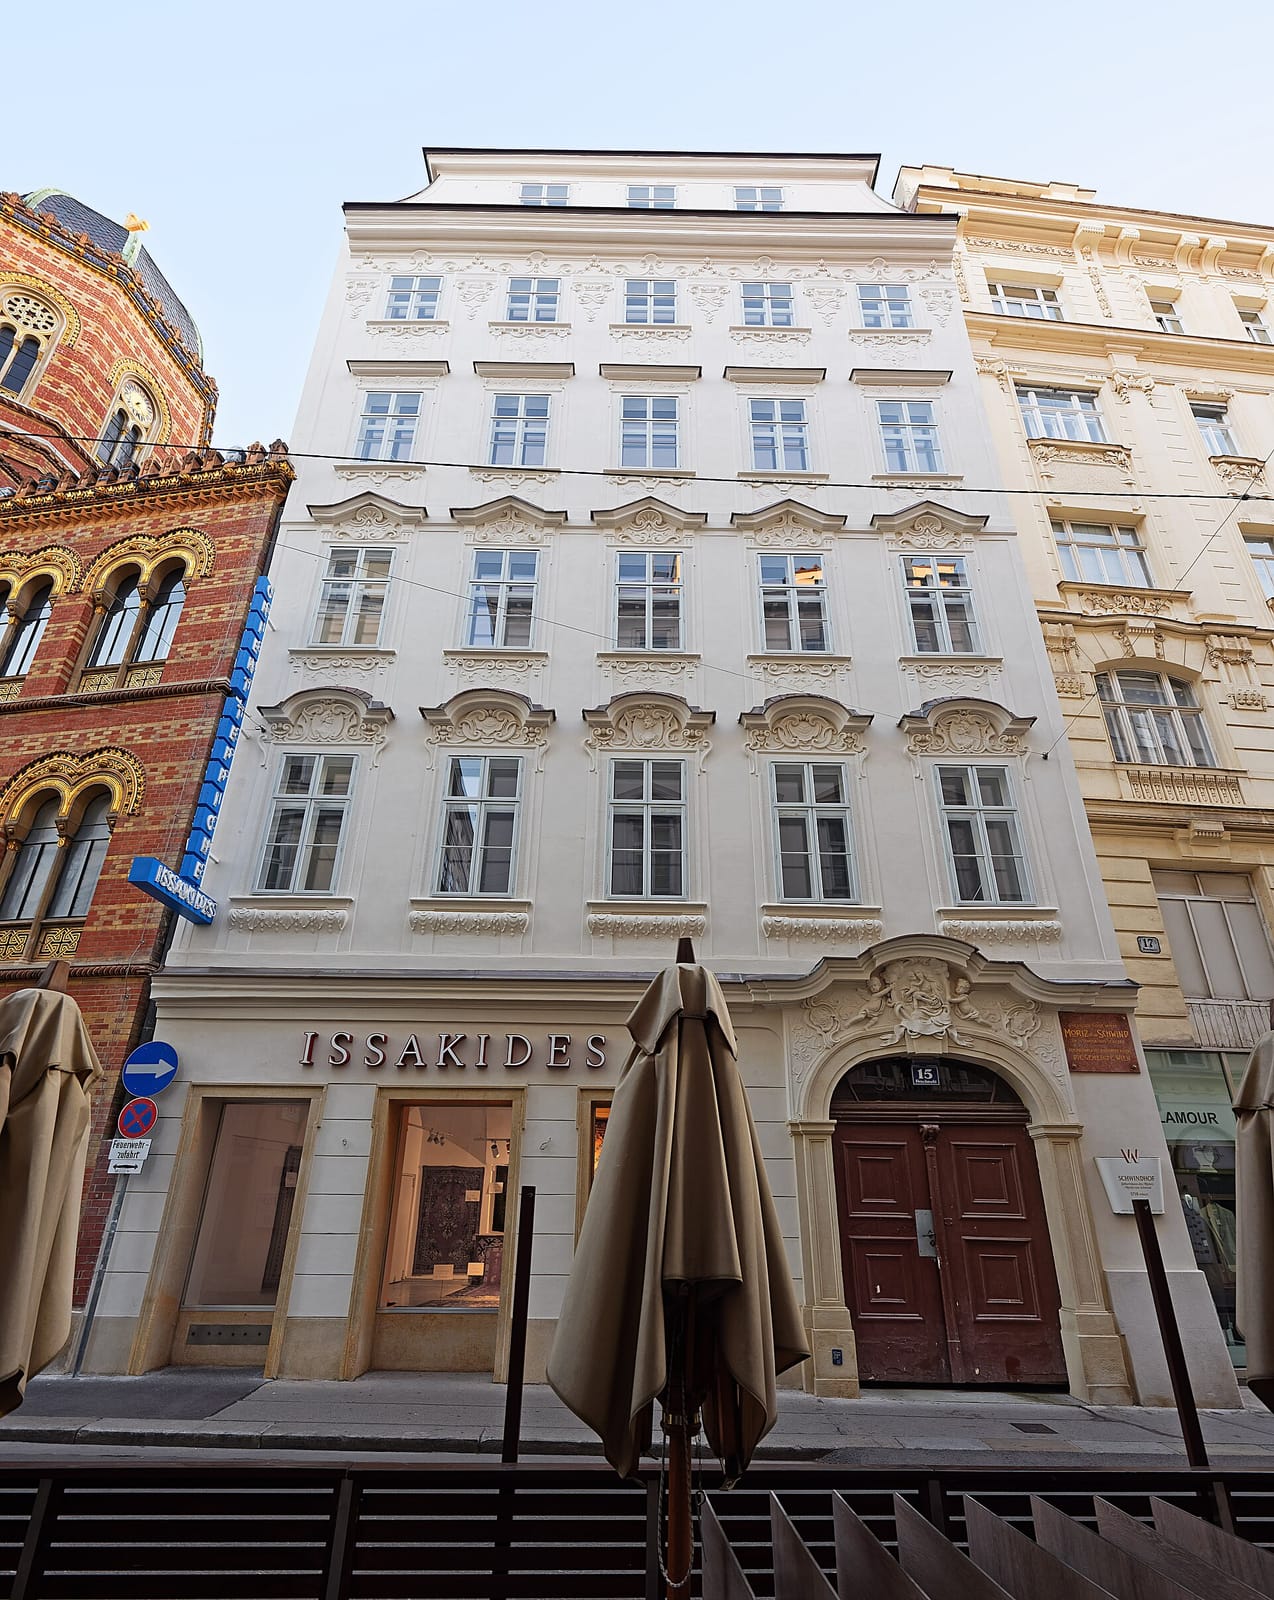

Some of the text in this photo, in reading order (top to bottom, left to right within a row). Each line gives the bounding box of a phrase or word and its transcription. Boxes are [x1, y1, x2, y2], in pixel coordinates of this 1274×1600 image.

[155, 865, 218, 917] ISSAKIDES
[1143, 938, 1153, 947] 17
[1097, 1030, 1129, 1038] SCHWIND
[299, 1031, 608, 1067] ISSAKIDES
[918, 1068, 933, 1080] 15
[1161, 1111, 1219, 1125] AMOUR
[112, 1140, 150, 1149] Feuerwehr-
[117, 1150, 140, 1159] zufahrt
